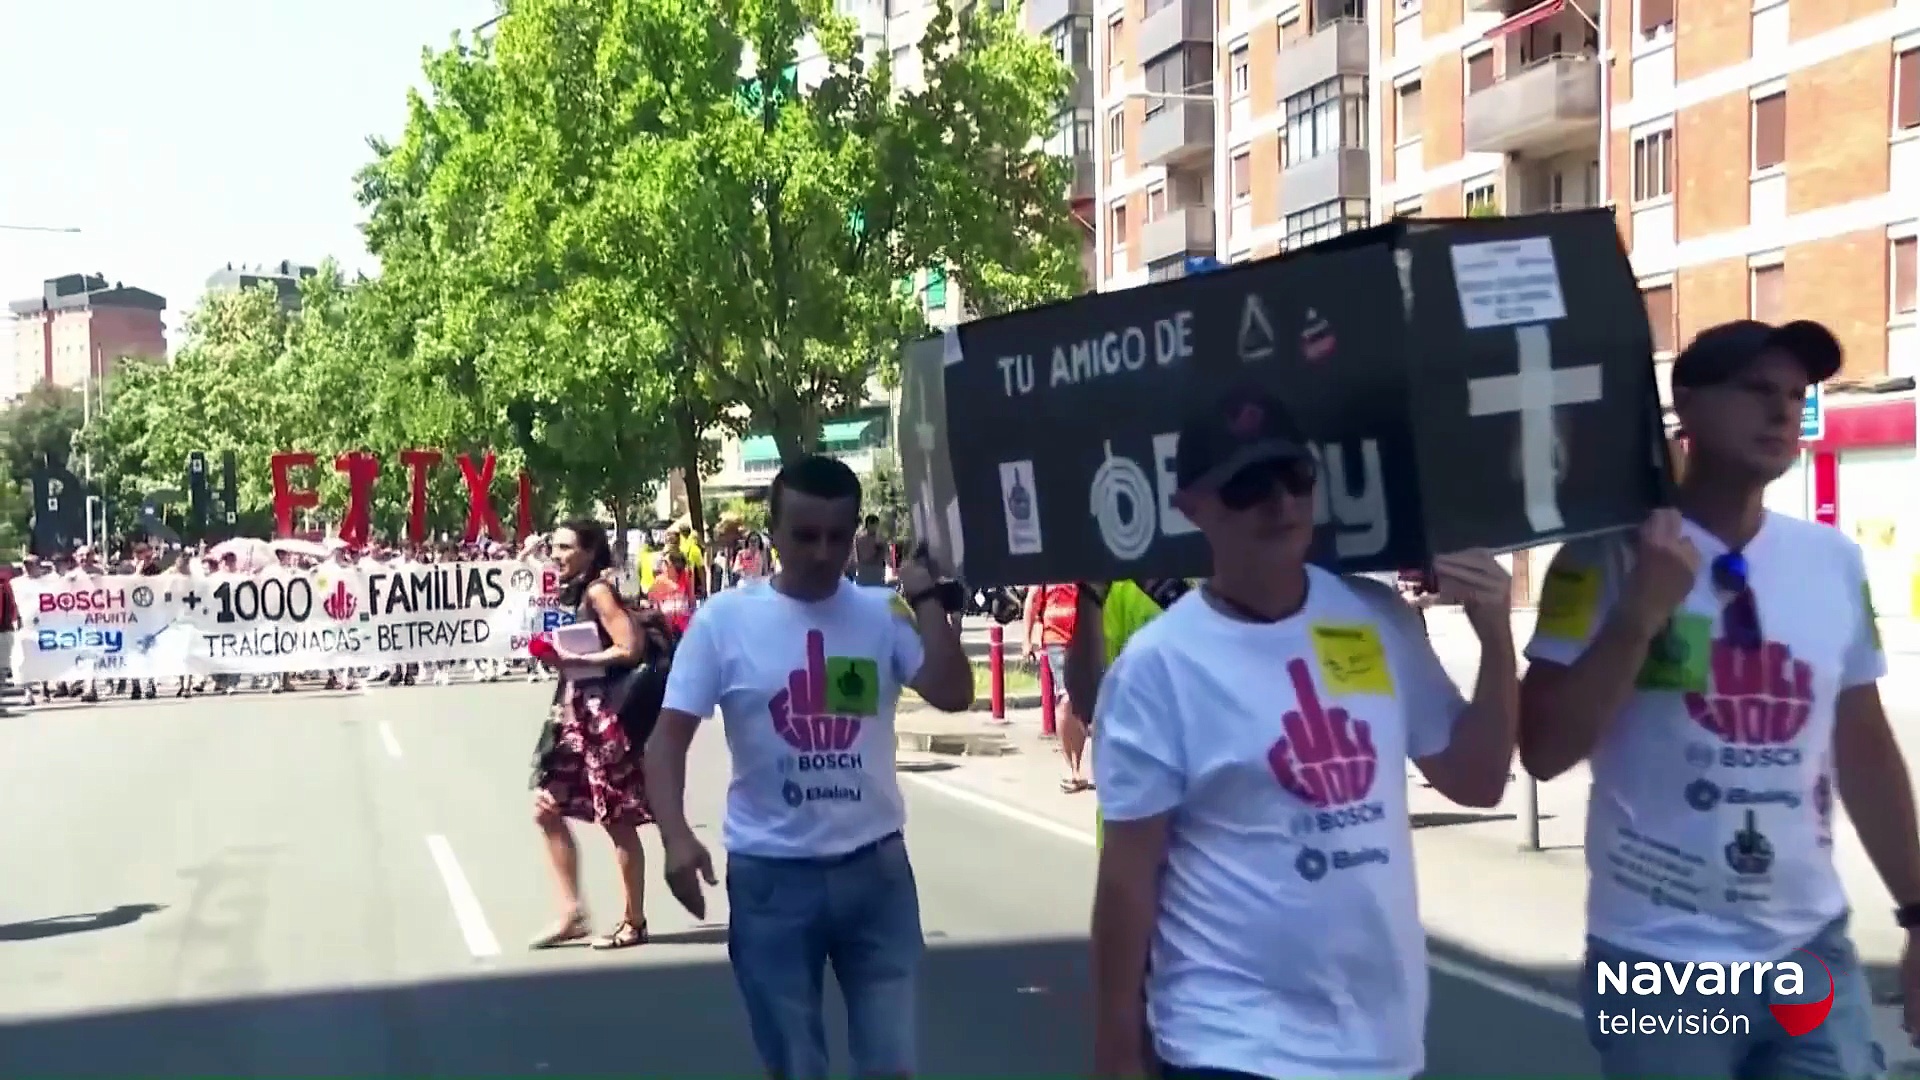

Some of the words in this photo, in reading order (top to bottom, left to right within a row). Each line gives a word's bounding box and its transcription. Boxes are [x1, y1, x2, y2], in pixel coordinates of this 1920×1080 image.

[998, 355, 1034, 397] TU
[1050, 326, 1146, 388] AMIGO
[1154, 310, 1194, 366] DE
[39, 588, 125, 613] BOSCH
[214, 576, 313, 623] 1000
[368, 564, 506, 617] FAMILIAS
[37, 627, 123, 653] Balay
[377, 618, 490, 652] BETRAYED
[798, 753, 863, 771] BOSCH
